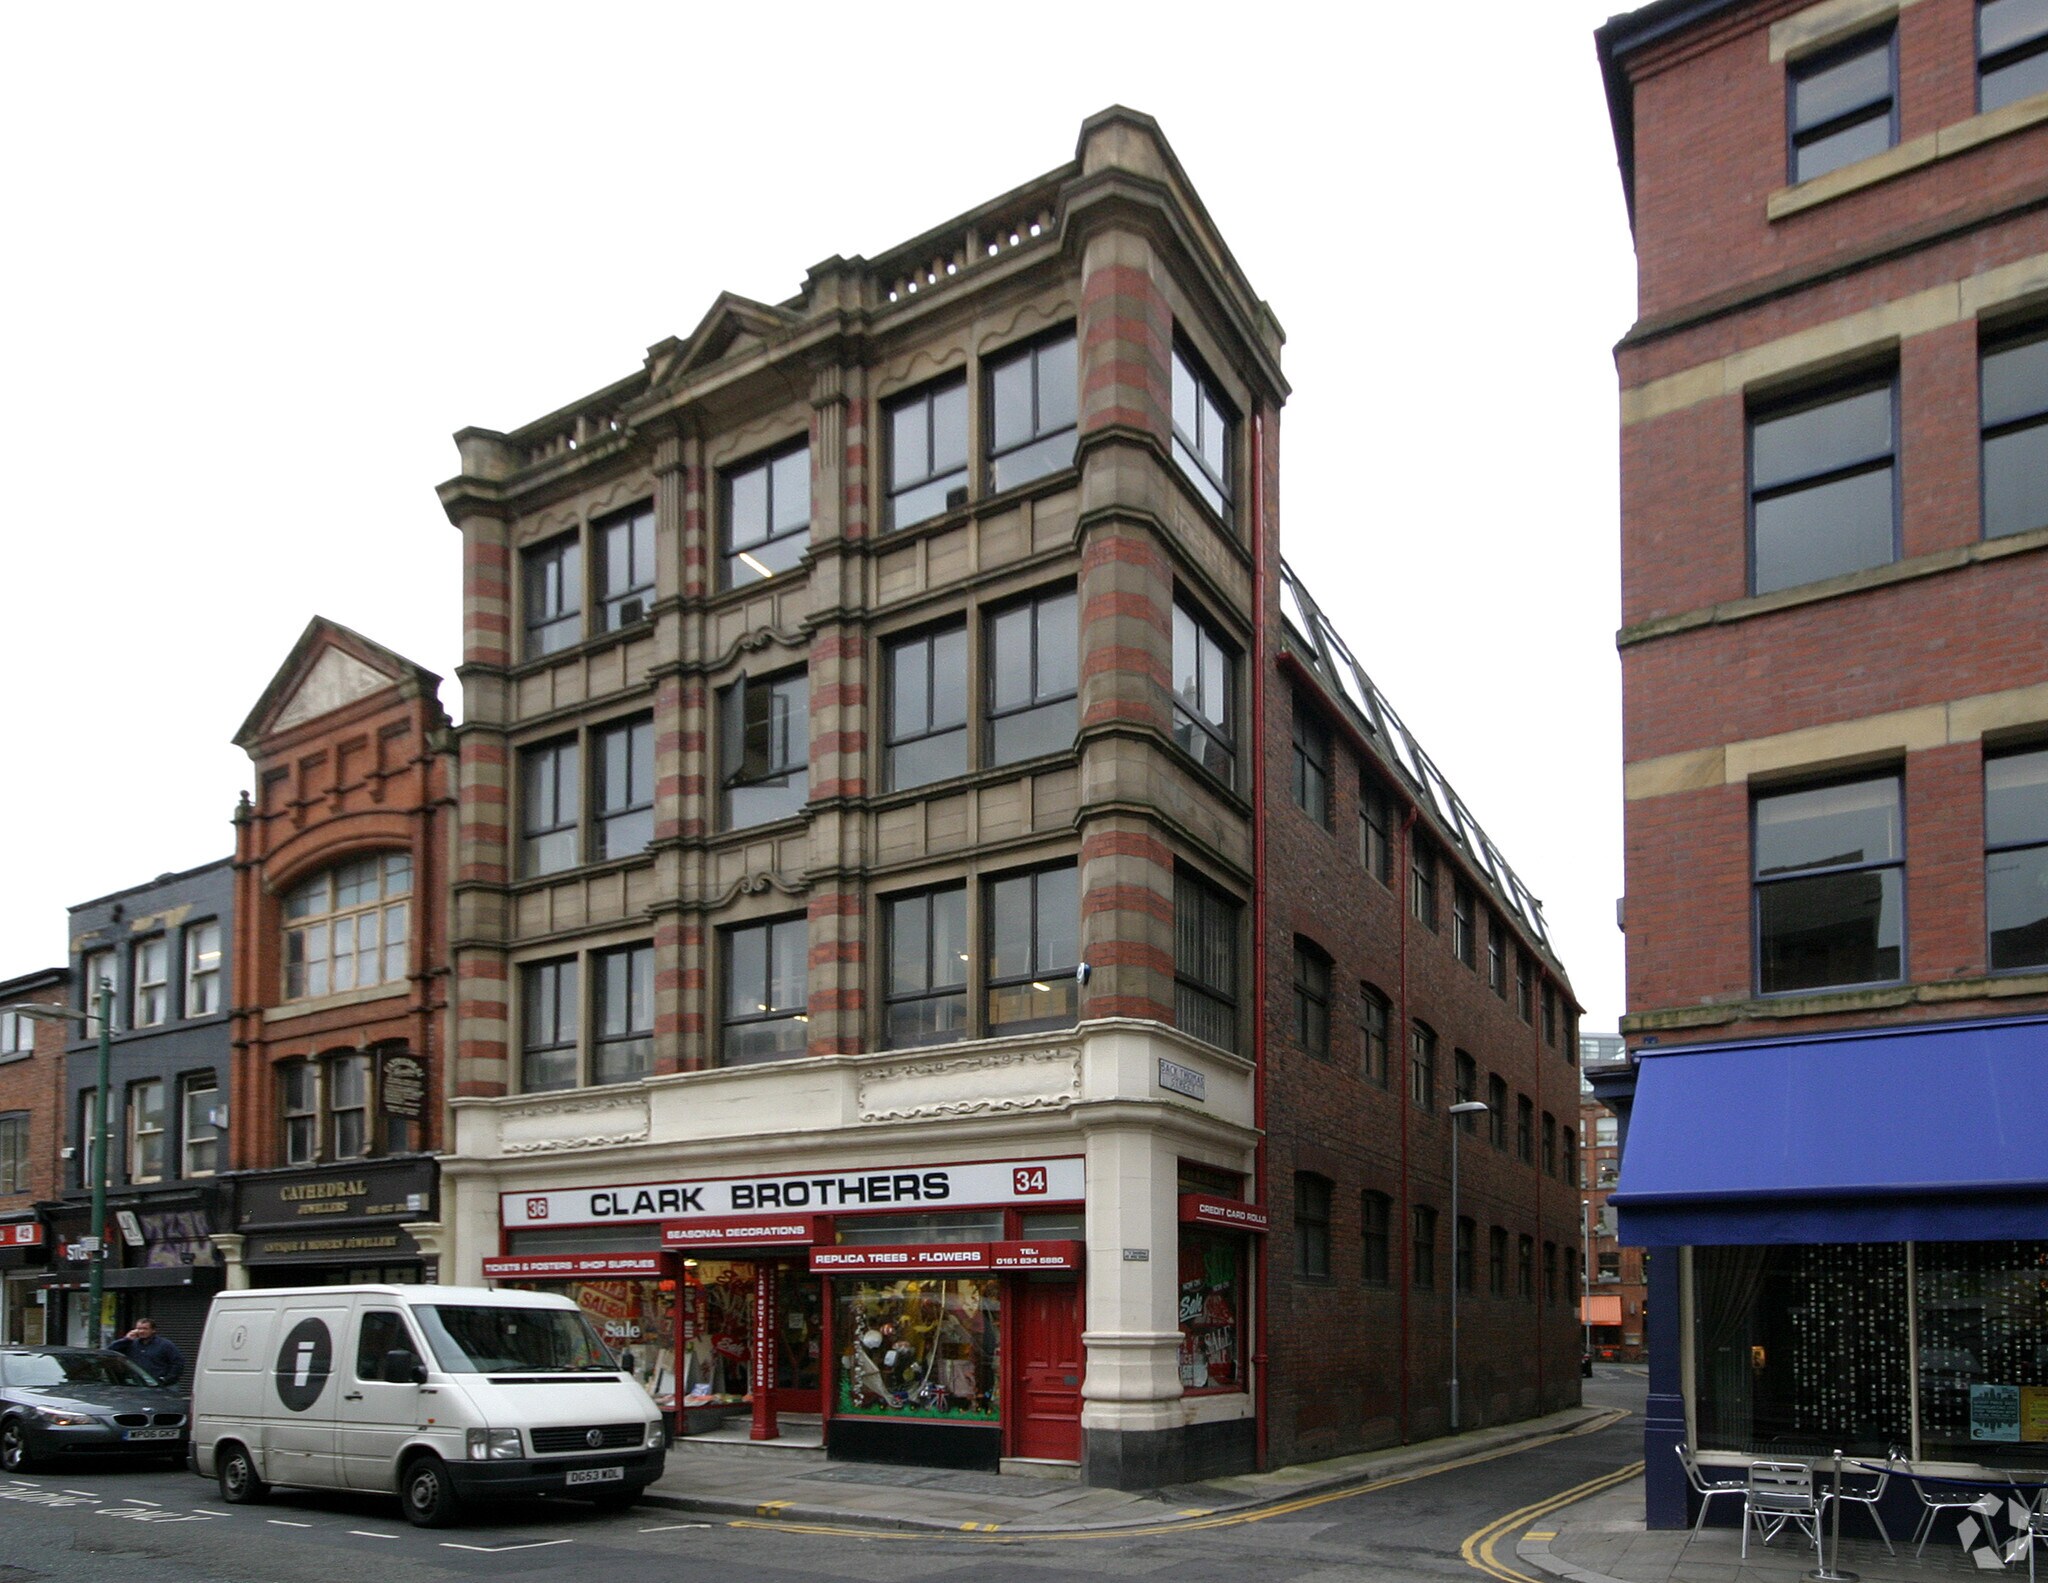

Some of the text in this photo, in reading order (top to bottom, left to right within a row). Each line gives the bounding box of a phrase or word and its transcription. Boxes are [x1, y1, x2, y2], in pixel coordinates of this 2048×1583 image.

[280, 1180, 367, 1201] CATHEDRAL
[1016, 1170, 1045, 1192] 34
[590, 1172, 950, 1217] CLARK BROTHERS
[528, 1198, 547, 1218] 36
[1199, 1203, 1267, 1224] CREDIT CARD ROLLS
[667, 1225, 805, 1240] SEASONAL DECORATIONS
[485, 1263, 521, 1272] TICKETS
[522, 1262, 529, 1271] &
[530, 1261, 573, 1271] POSTERS
[579, 1260, 607, 1270] SHOP
[608, 1259, 656, 1269] SUPPLIES
[815, 1253, 866, 1264] REPLICA
[867, 1252, 908, 1263] TREES
[919, 1251, 981, 1263] FLOWERS
[995, 1257, 1018, 1265] 0161
[757, 1298, 765, 1338] BUNTING
[605, 1320, 641, 1338] Sale
[571, 1470, 600, 1483] DG53
